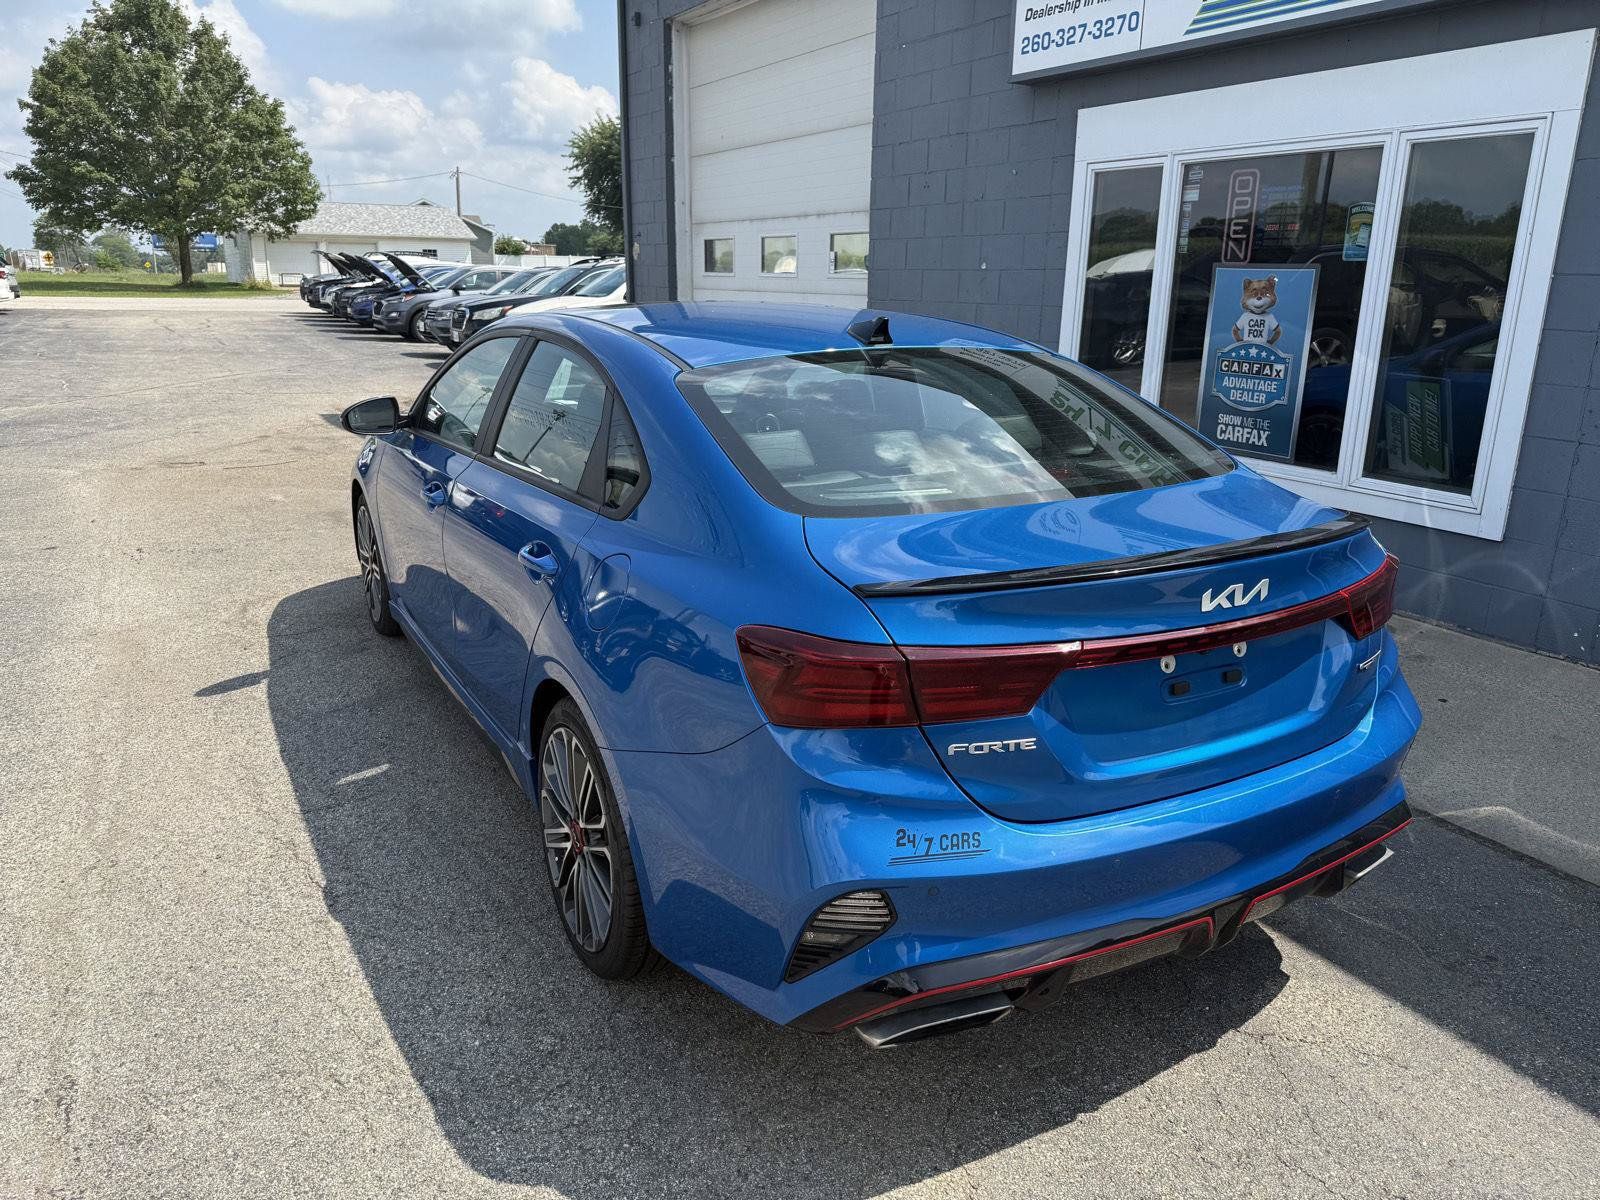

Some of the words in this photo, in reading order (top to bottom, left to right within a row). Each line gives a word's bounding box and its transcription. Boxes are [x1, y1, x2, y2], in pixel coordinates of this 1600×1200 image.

[1024, 0, 1080, 21] Dealership
[1021, 11, 1140, 55] 260-327-3270
[1227, 176, 1253, 260] OPEN
[1248, 319, 1265, 328] CAR
[1248, 329, 1264, 338] FOX
[1221, 360, 1283, 378] CARFAX
[1222, 376, 1278, 393] ADVANTAGE
[1230, 390, 1266, 404] DEALER
[1408, 392, 1421, 419] NEW
[1218, 413, 1242, 426] SHOW
[1243, 416, 1256, 427] ME
[1256, 418, 1271, 430] THE
[1217, 424, 1270, 447] CARFAX
[1409, 419, 1423, 457] HAPPY
[1201, 578, 1269, 612] KIA
[947, 738, 1036, 756] FORTE
[895, 828, 934, 857] 24/7
[940, 832, 981, 851] CARS
